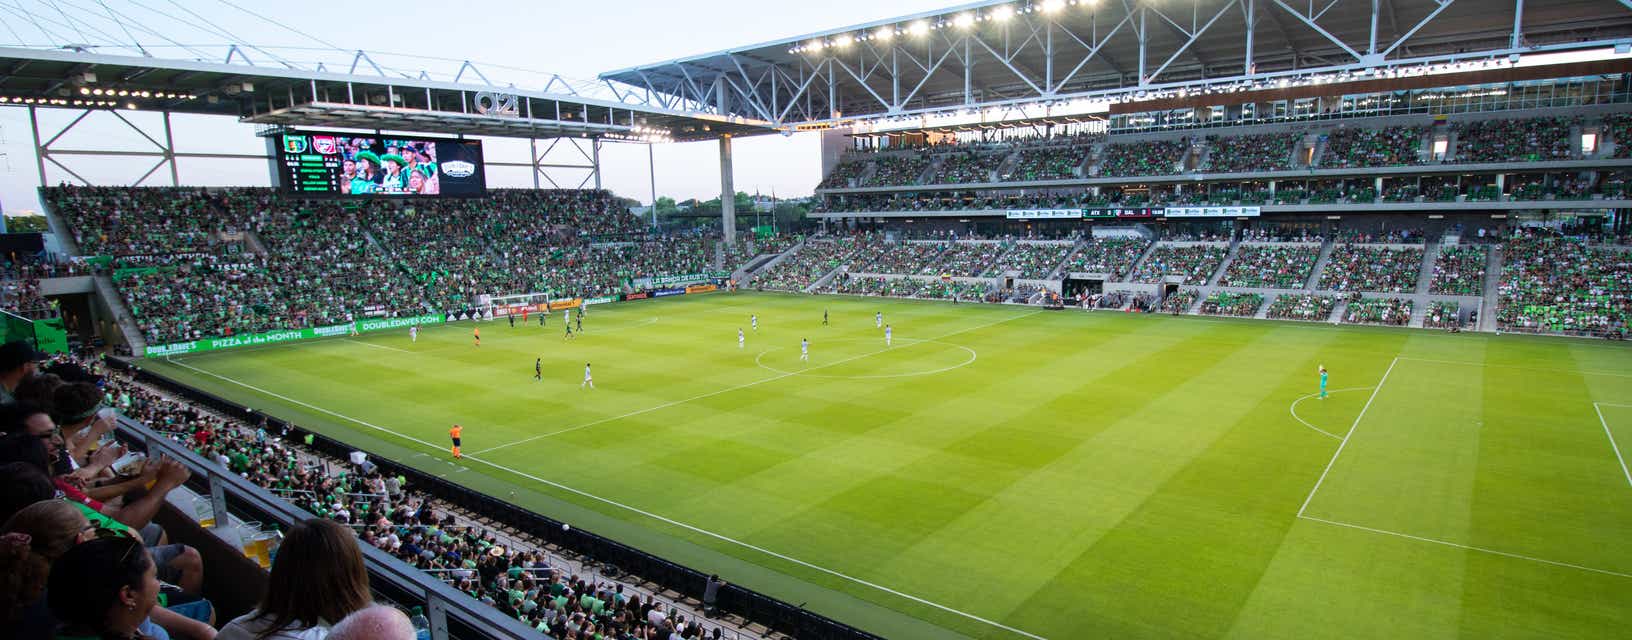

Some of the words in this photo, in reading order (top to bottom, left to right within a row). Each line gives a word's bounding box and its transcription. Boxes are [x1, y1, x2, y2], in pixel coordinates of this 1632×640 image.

[212, 338, 241, 348] PIZZA
[243, 336, 251, 344] of
[252, 335, 265, 343] the
[266, 331, 302, 342] MONTH
